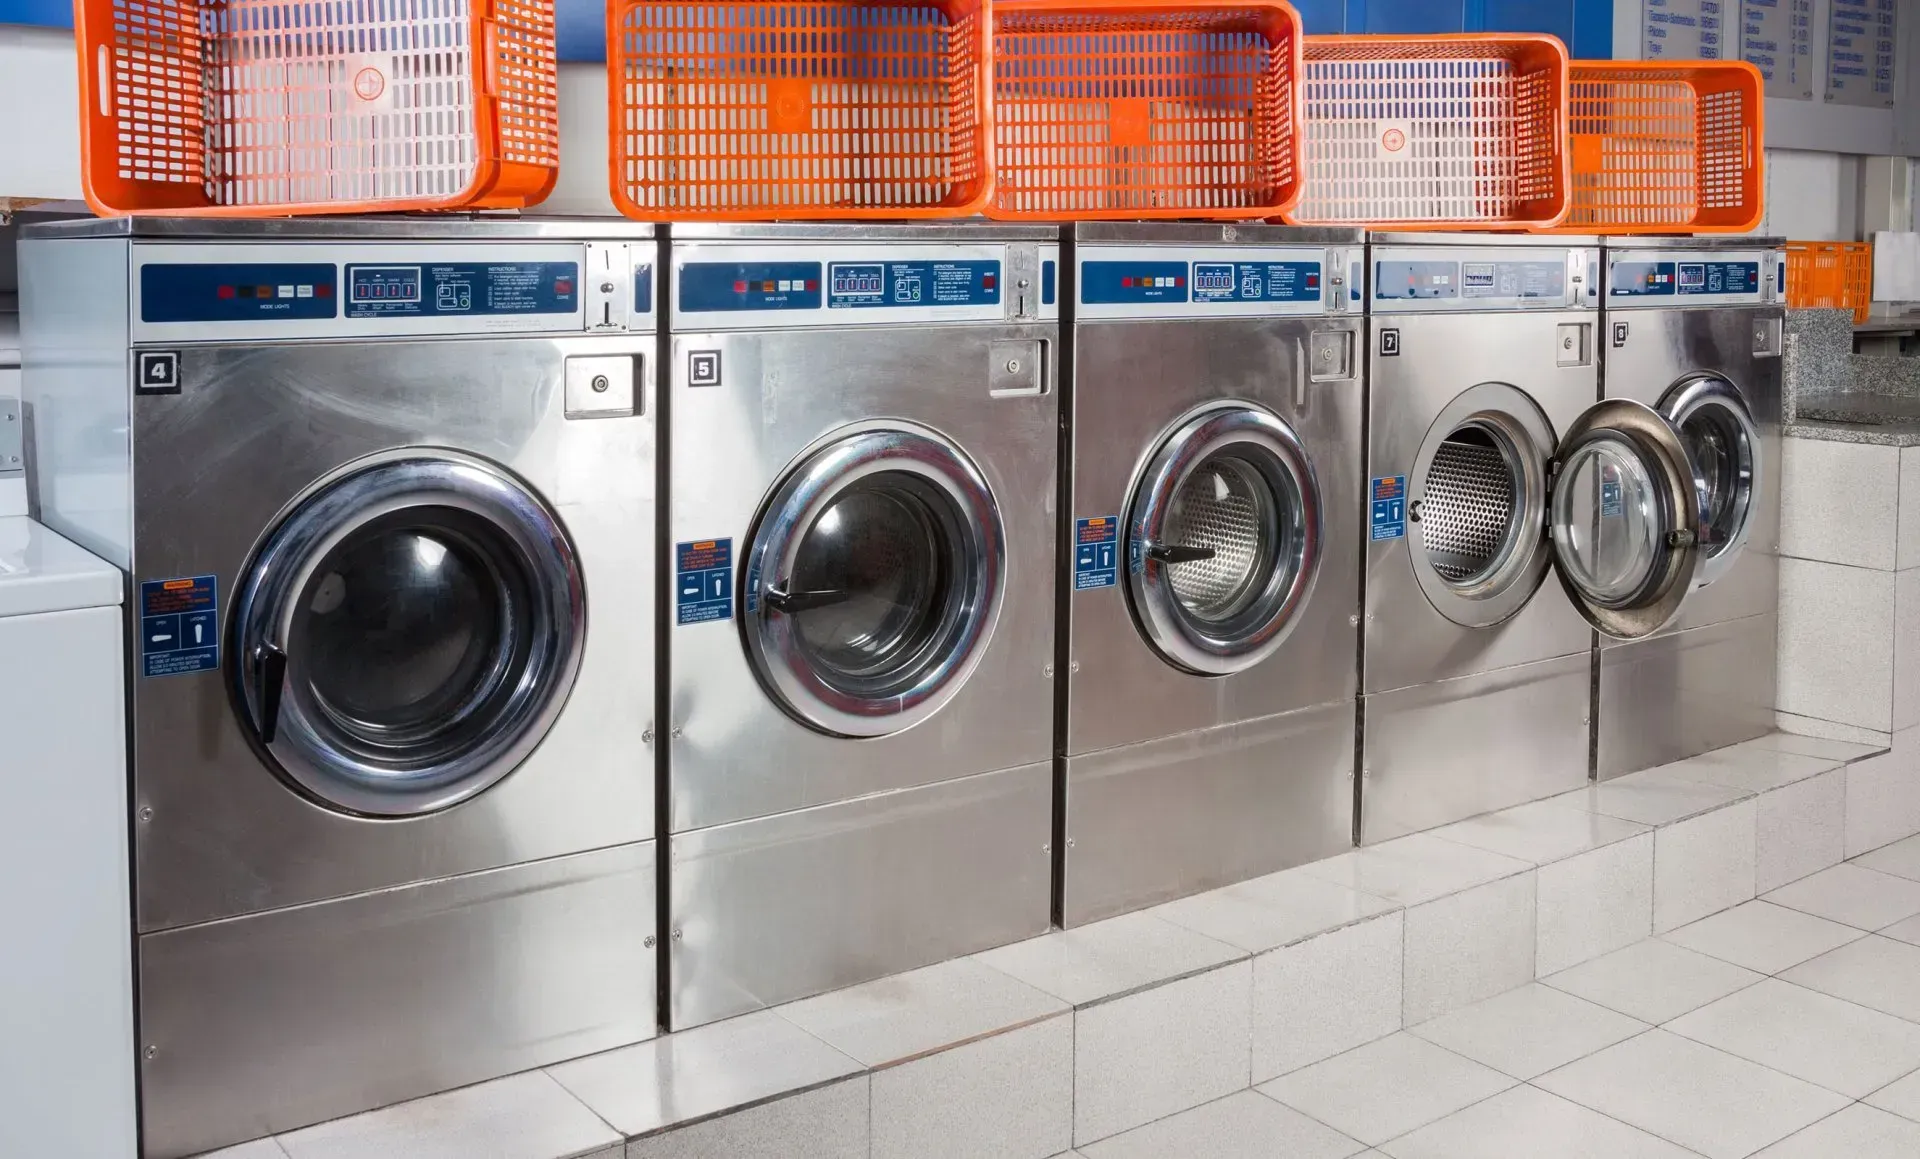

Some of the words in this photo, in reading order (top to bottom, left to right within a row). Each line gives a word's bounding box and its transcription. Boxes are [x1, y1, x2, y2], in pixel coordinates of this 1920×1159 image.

[1386, 336, 1394, 348] 7
[151, 362, 166, 379] 4
[698, 361, 710, 377] 5
